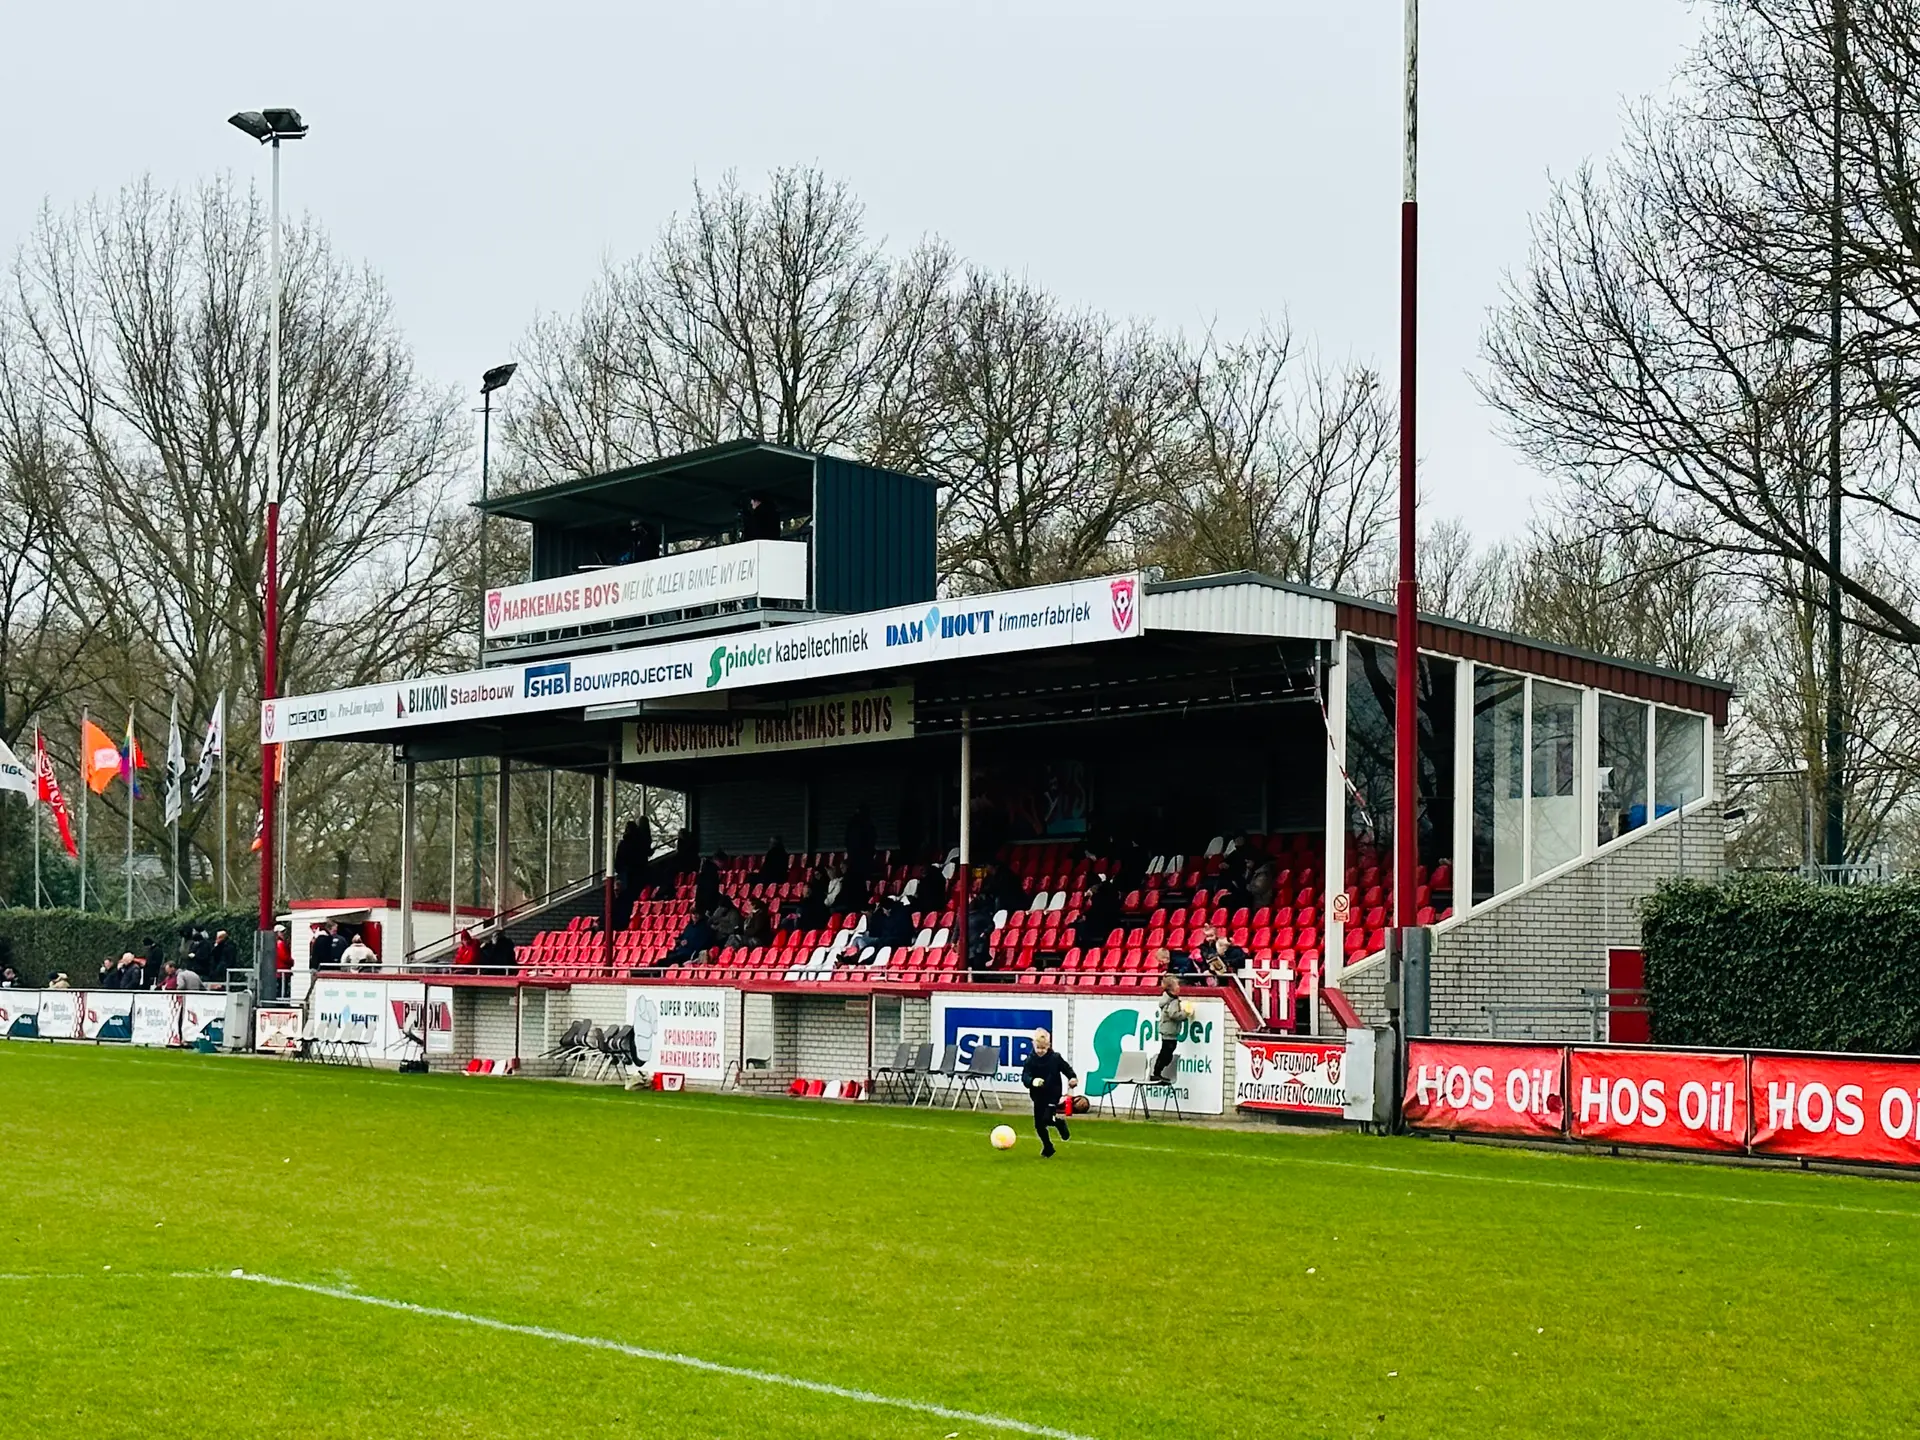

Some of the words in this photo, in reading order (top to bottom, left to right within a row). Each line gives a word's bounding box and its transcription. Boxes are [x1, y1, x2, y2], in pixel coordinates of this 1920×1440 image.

[503, 589, 580, 621] HARKEMASE
[584, 582, 619, 609] BOYS
[622, 582, 641, 602] MEI
[656, 570, 685, 593] ALLEN
[688, 566, 717, 590] BINNE
[719, 563, 736, 584] WY
[736, 558, 756, 582] IEN
[886, 621, 924, 647] DAM
[941, 610, 994, 639] HOUT
[999, 600, 1091, 632] timmerfabriek
[706, 645, 772, 688] Spinder
[775, 628, 869, 662] kabeltechniek
[409, 684, 447, 714] BIJKON
[450, 682, 514, 706] Staalbouw
[529, 674, 565, 697] SHB
[573, 662, 693, 692] BOUWPROJECTEN
[852, 695, 892, 735] BOYS
[660, 1000, 682, 1016] SUPER
[684, 1000, 720, 1018] SPONSORS
[664, 1029, 718, 1048] SPONSORGROEP
[660, 1050, 700, 1068] HARKEMASE
[702, 1051, 721, 1069] BOYS
[1273, 1053, 1301, 1071] STEUN
[1304, 1055, 1317, 1073] DE
[1238, 1082, 1300, 1104] ACTIEVITEITEN
[1417, 1064, 1495, 1111] HOS
[1506, 1067, 1552, 1115] Oil
[1580, 1076, 1667, 1127] HOS
[1679, 1080, 1734, 1132] Oil
[1766, 1081, 1865, 1136] HOS
